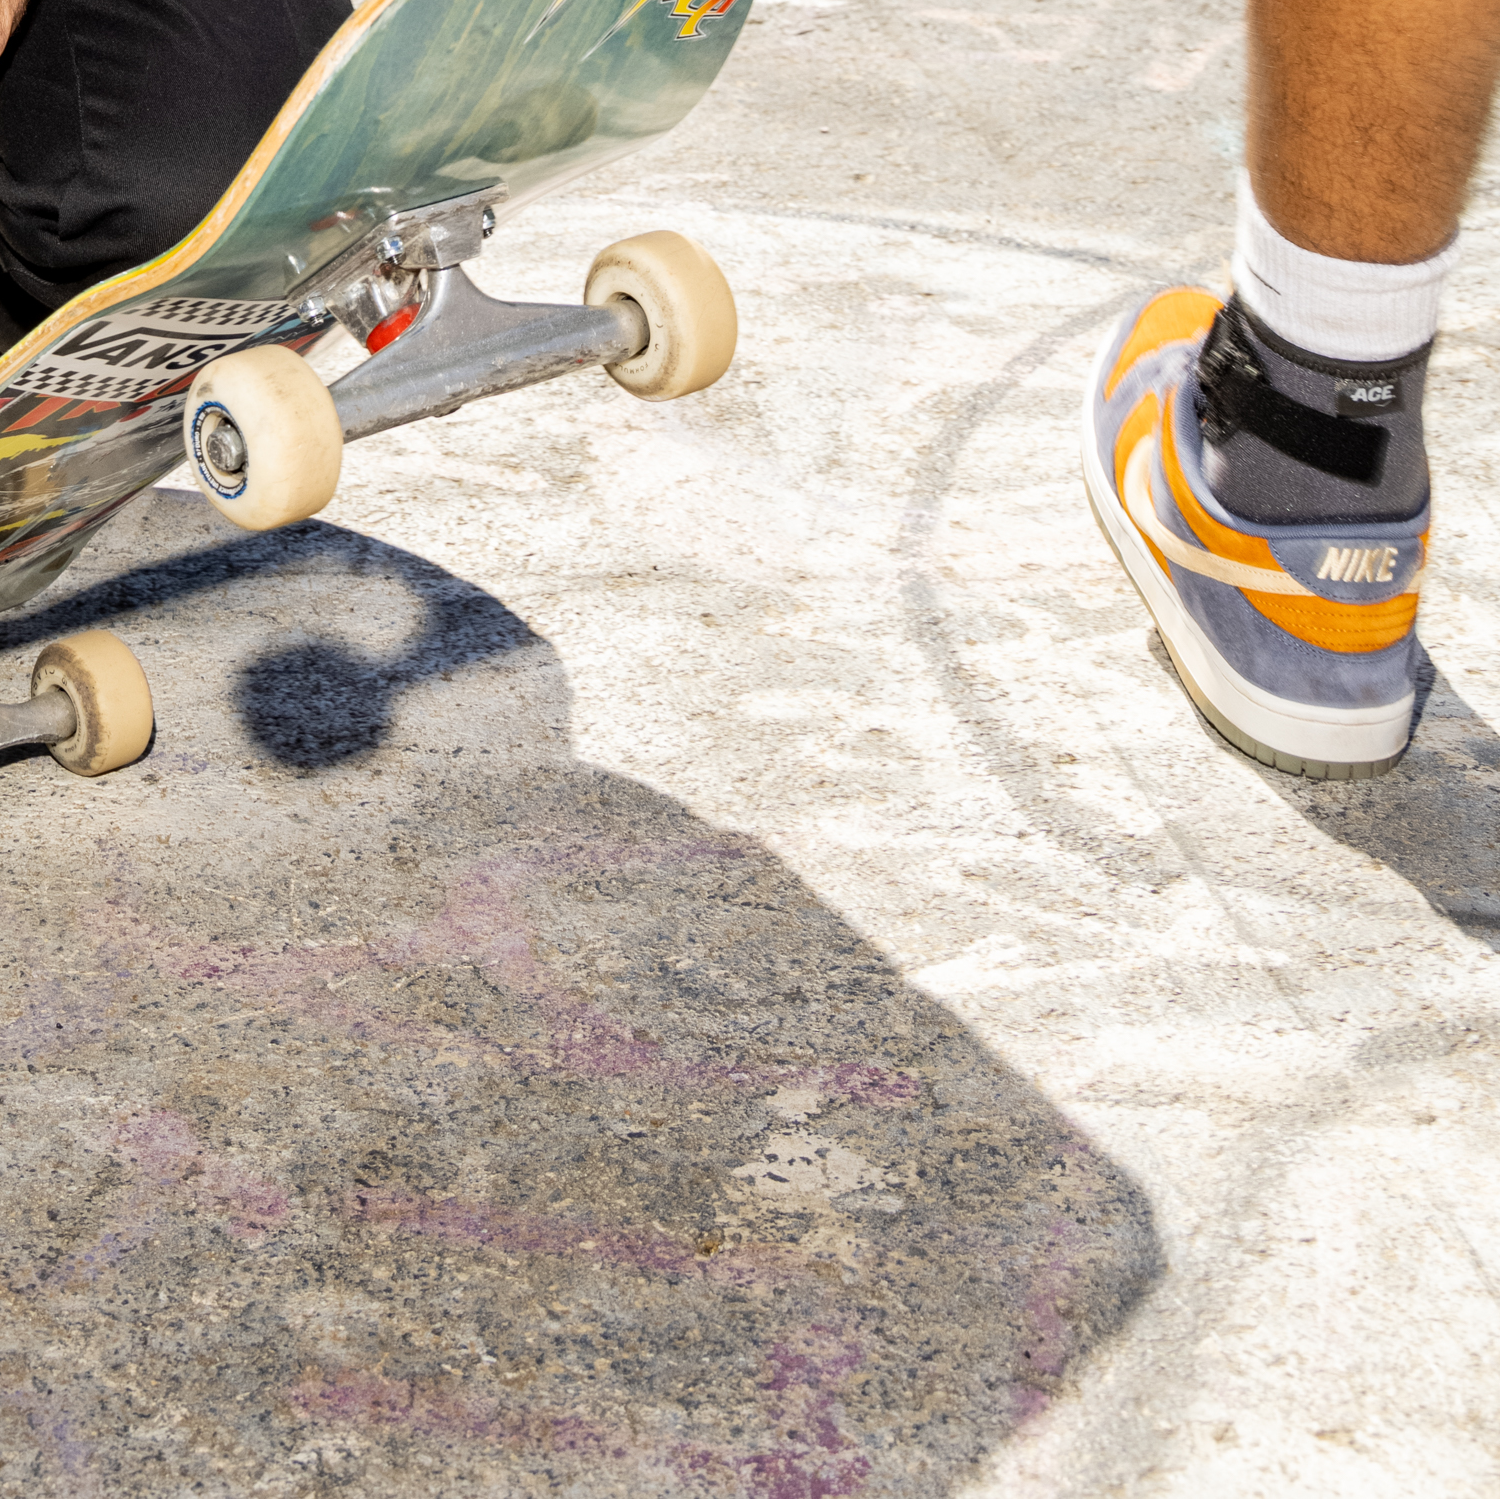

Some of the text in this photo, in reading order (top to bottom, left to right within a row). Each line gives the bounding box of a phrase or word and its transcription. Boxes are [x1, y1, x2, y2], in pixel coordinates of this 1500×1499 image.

[52, 320, 256, 370] VANS
[1350, 383, 1395, 404] ACE
[1316, 546, 1399, 583] NIKE
